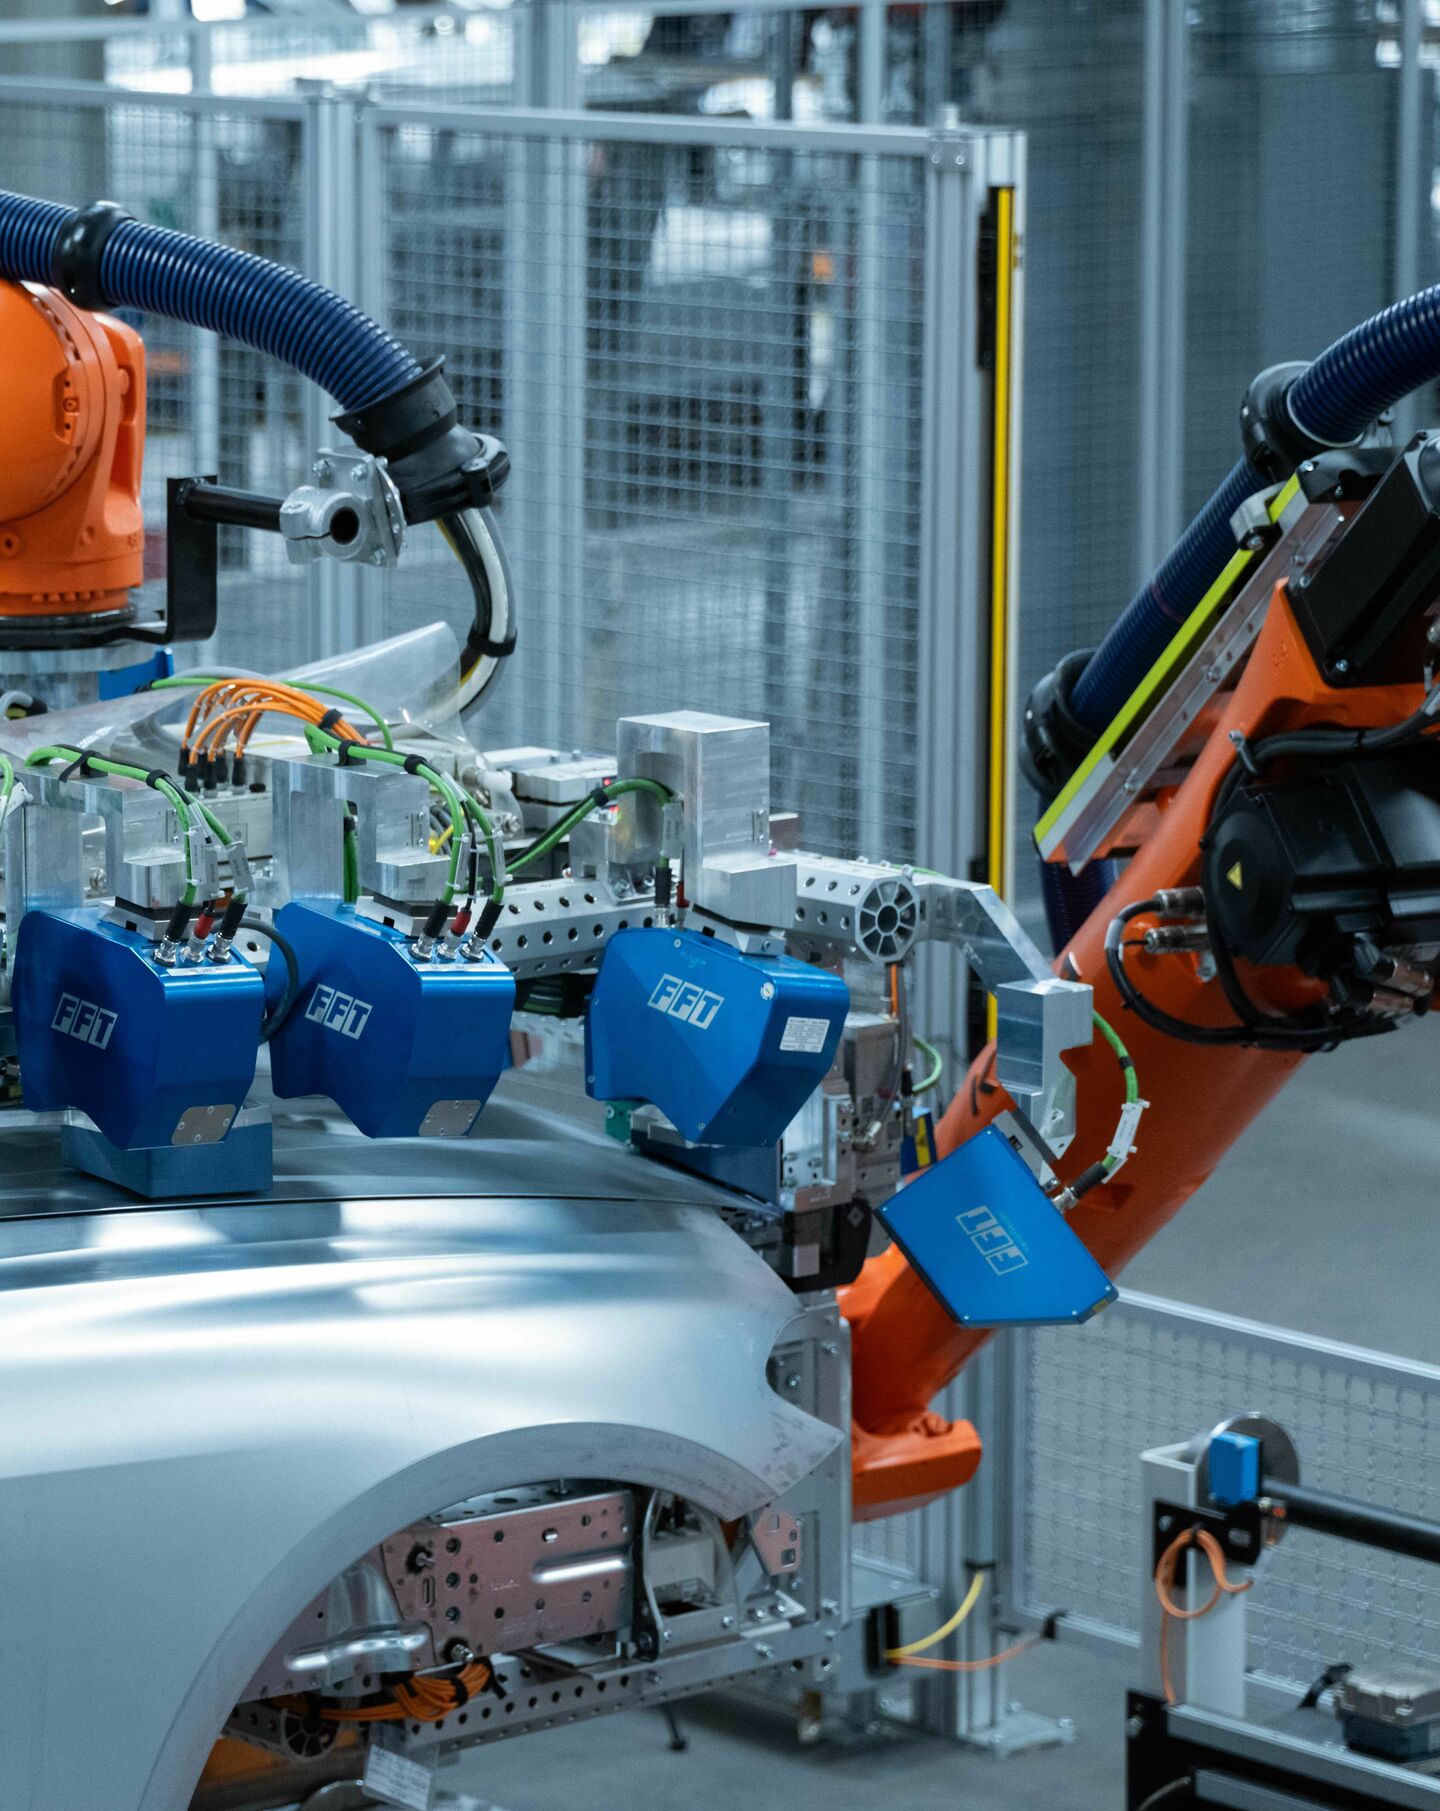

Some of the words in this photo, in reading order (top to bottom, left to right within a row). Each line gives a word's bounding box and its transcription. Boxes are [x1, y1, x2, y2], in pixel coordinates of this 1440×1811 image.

[51, 992, 118, 1050] FFT
[304, 983, 373, 1040] FFT
[647, 973, 725, 1030] FFT
[955, 1205, 1029, 1276] FFT
